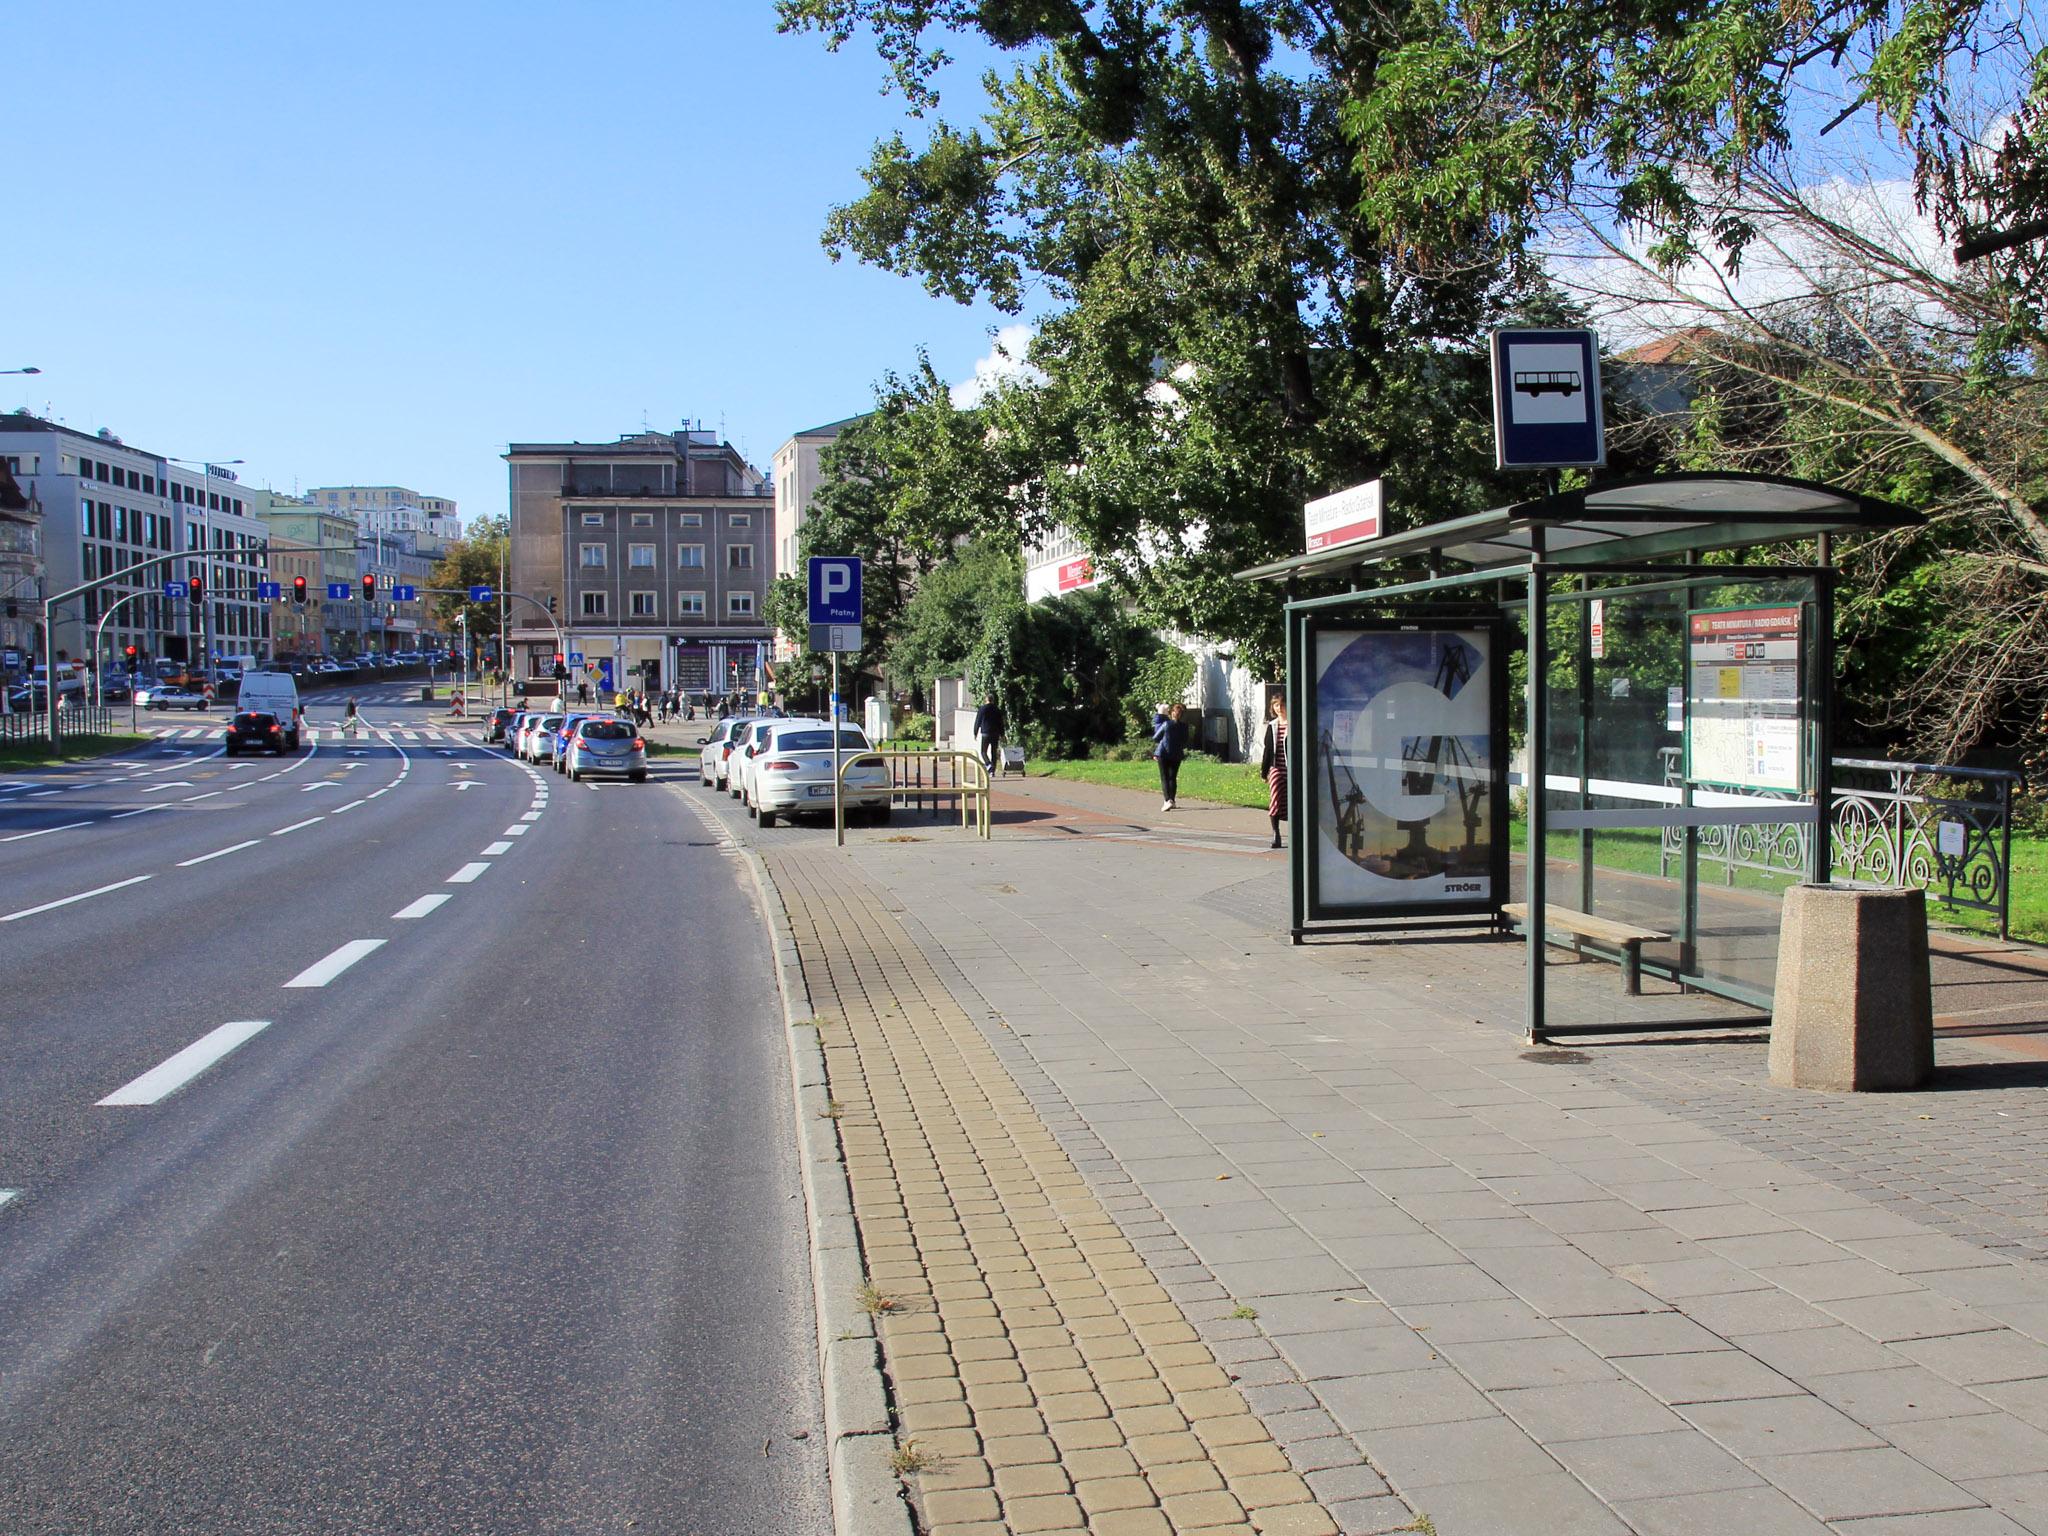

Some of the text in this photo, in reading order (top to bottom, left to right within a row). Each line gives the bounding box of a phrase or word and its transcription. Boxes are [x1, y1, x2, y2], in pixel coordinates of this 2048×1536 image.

[821, 563, 851, 605] P
[830, 609, 855, 618] Płatny
[1445, 883, 1481, 892] STRÖER
